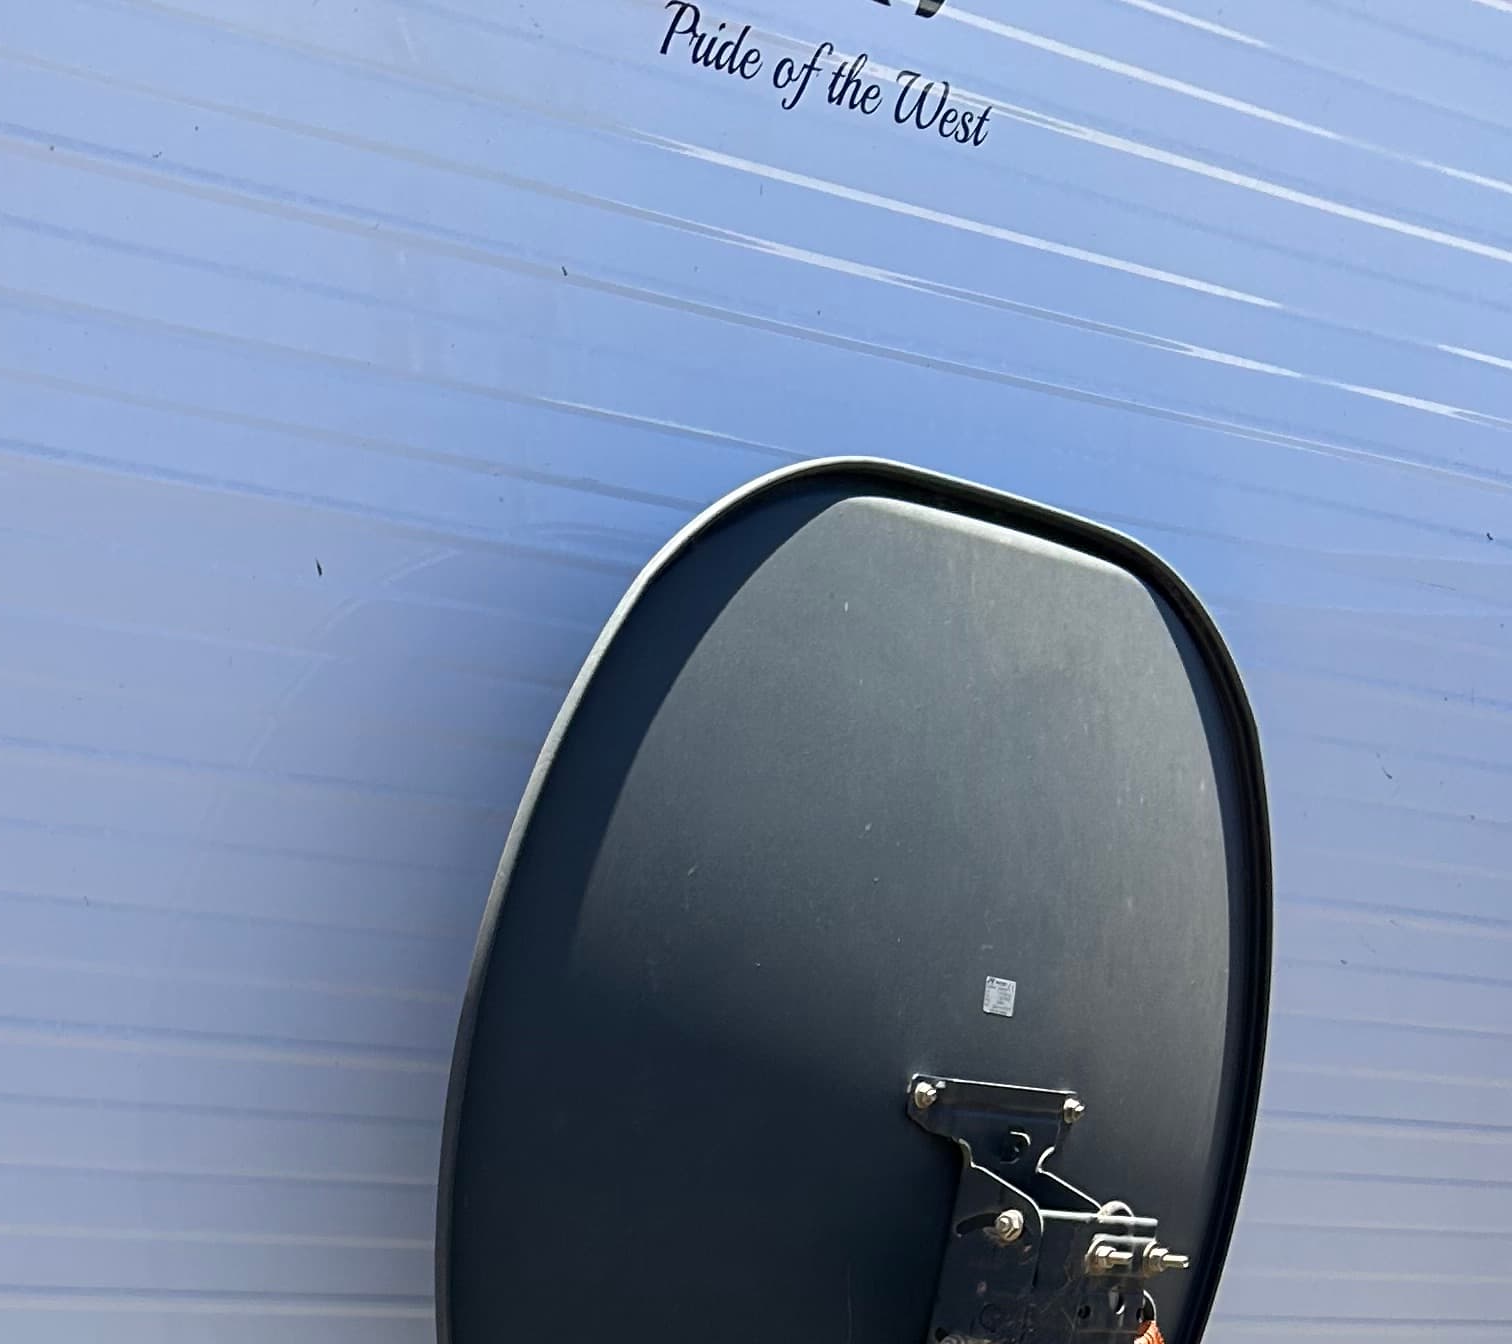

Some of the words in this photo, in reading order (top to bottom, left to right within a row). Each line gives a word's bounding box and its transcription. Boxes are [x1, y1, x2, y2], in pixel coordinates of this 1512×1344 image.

[659, 0, 762, 80] Pride
[773, 42, 834, 110] of
[828, 53, 882, 114] the
[893, 70, 992, 147] West
